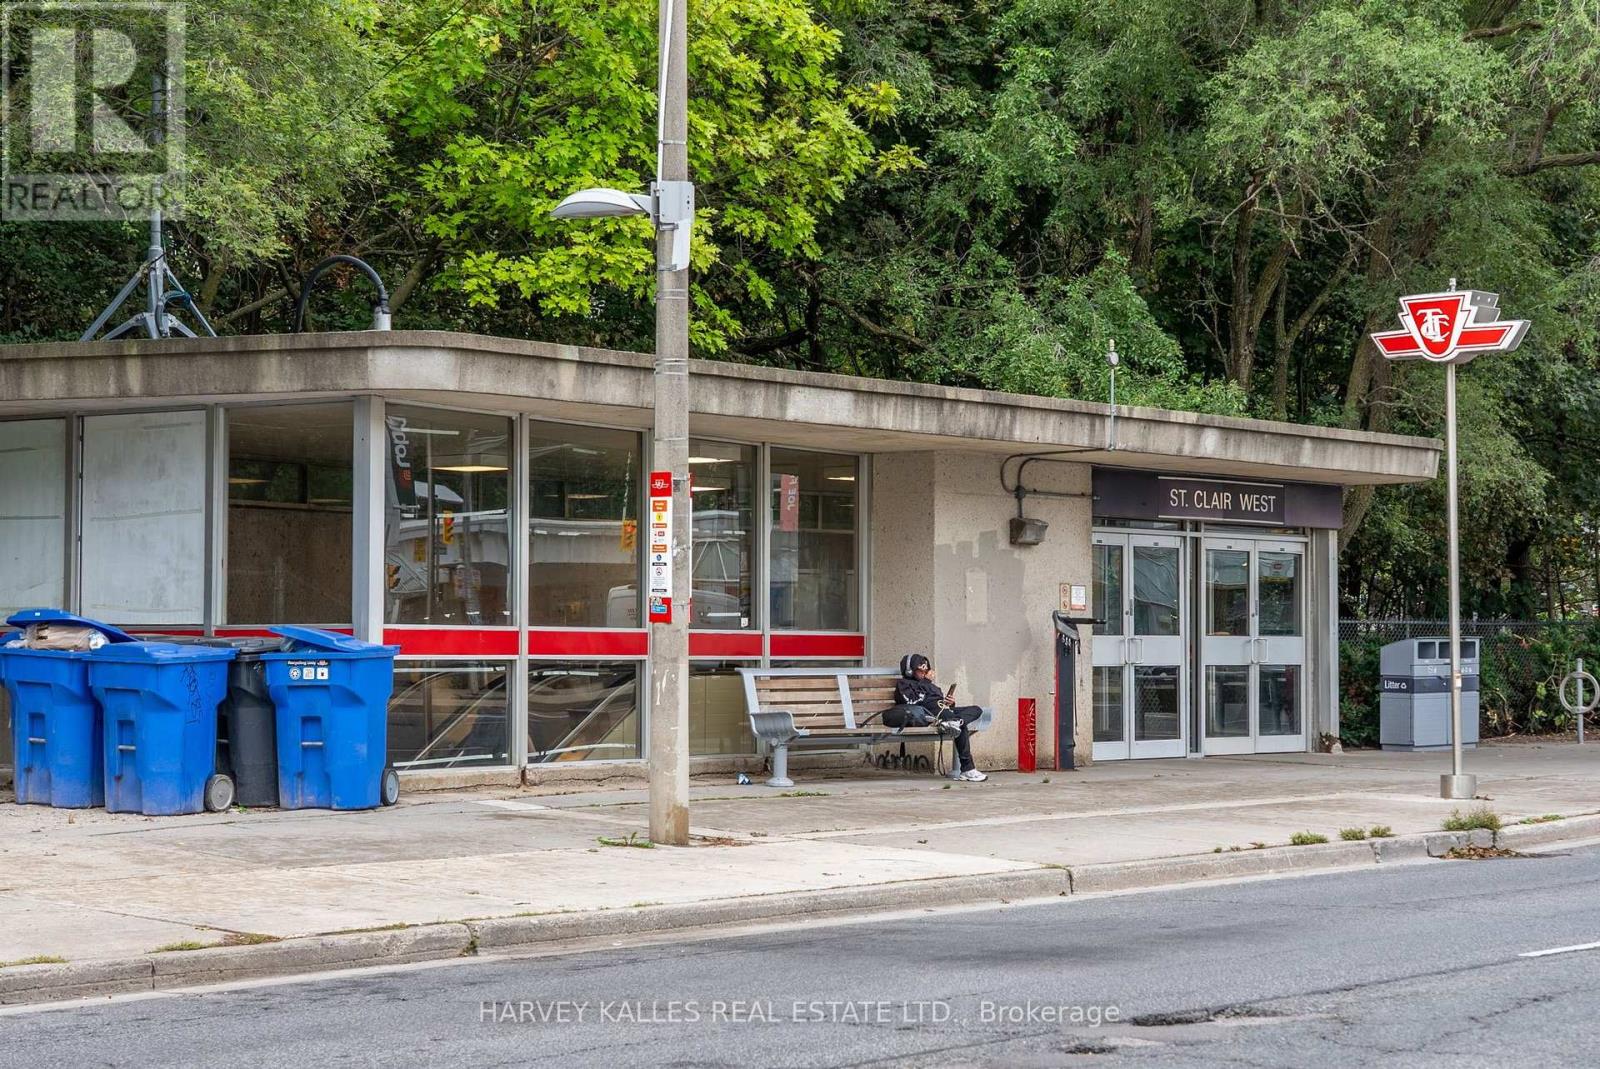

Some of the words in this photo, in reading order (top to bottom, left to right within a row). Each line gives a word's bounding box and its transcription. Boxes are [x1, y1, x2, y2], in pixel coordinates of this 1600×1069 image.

[1169, 488, 1189, 507] ST.
[1194, 490, 1232, 510] CLAIR
[1240, 493, 1276, 513] WEST
[1384, 680, 1400, 689] Litter
